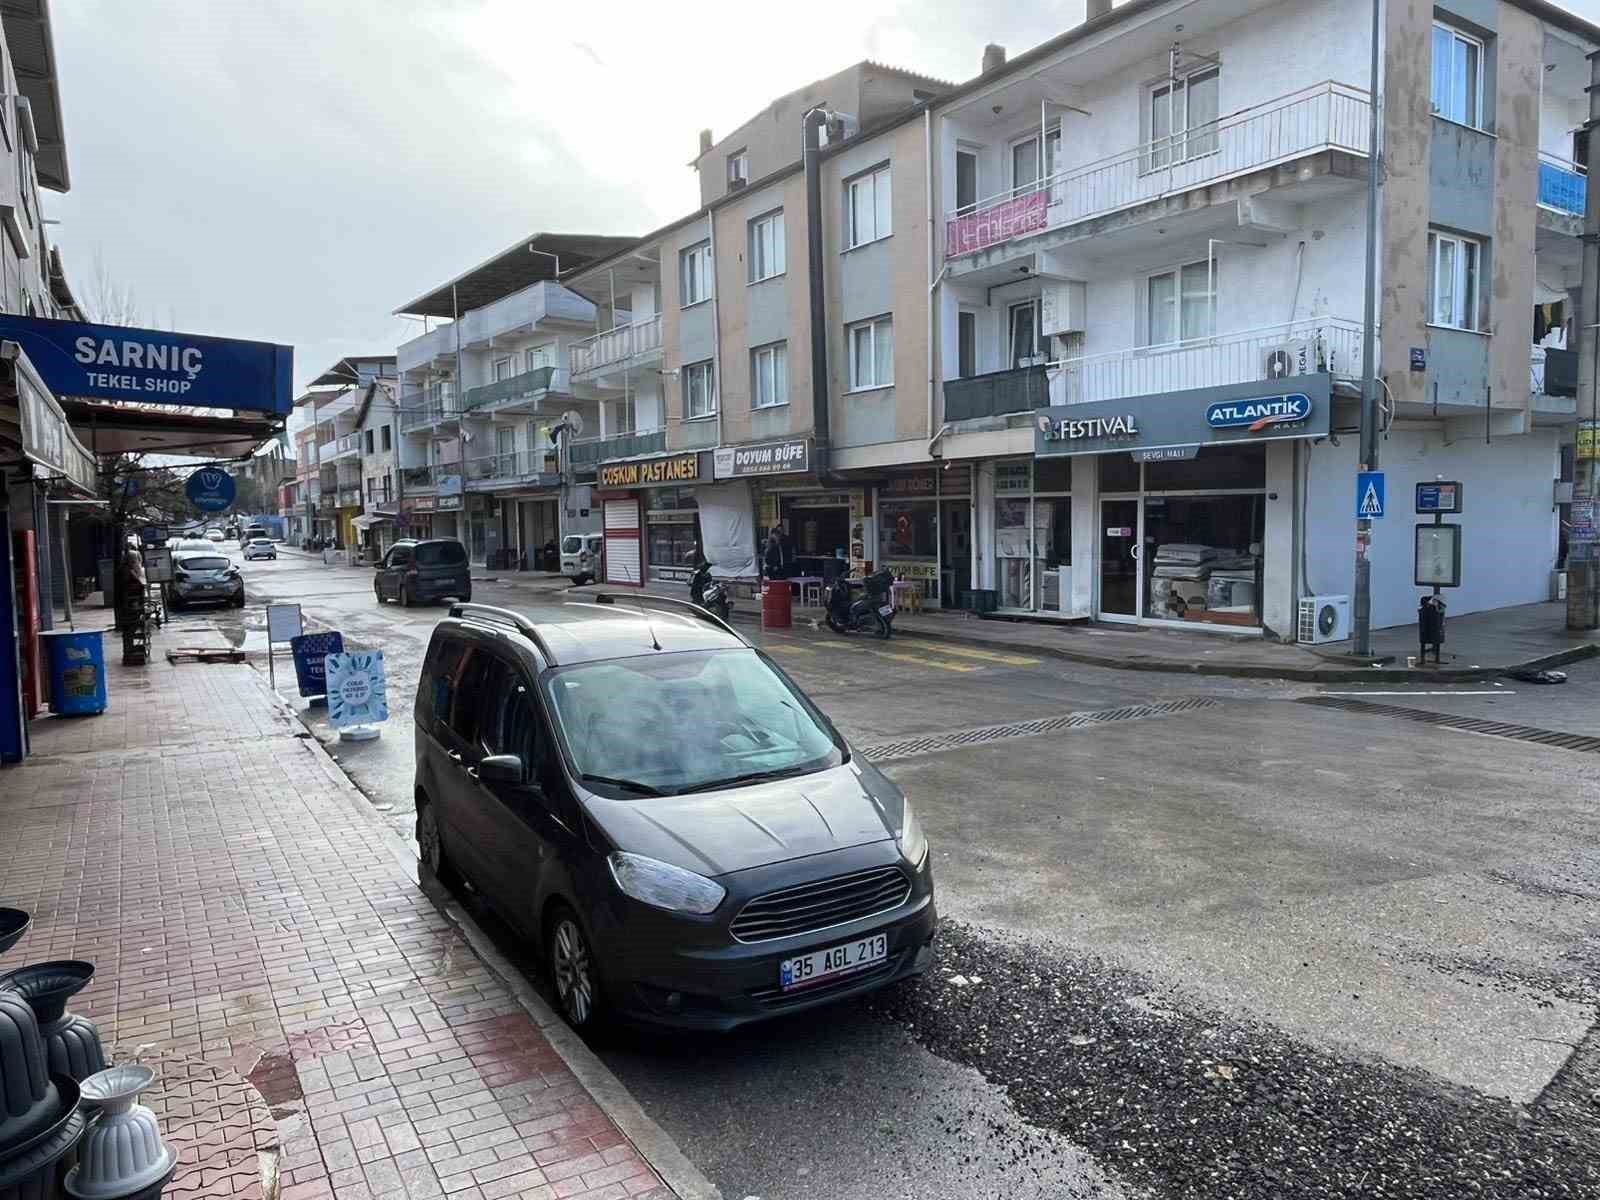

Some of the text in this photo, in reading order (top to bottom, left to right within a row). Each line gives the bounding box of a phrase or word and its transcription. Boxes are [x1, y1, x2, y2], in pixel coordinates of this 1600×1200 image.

[75, 336, 203, 380] SARNIÇ
[86, 372, 192, 394] TEKEL SHOP
[1210, 395, 1302, 421] ATLANTİK
[1061, 415, 1138, 440] FESTIVAL
[736, 450, 772, 465] DOYUM
[774, 443, 804, 462] BÜFE
[793, 957, 813, 978] 35
[824, 947, 852, 972] AGL
[858, 936, 886, 961] 213
